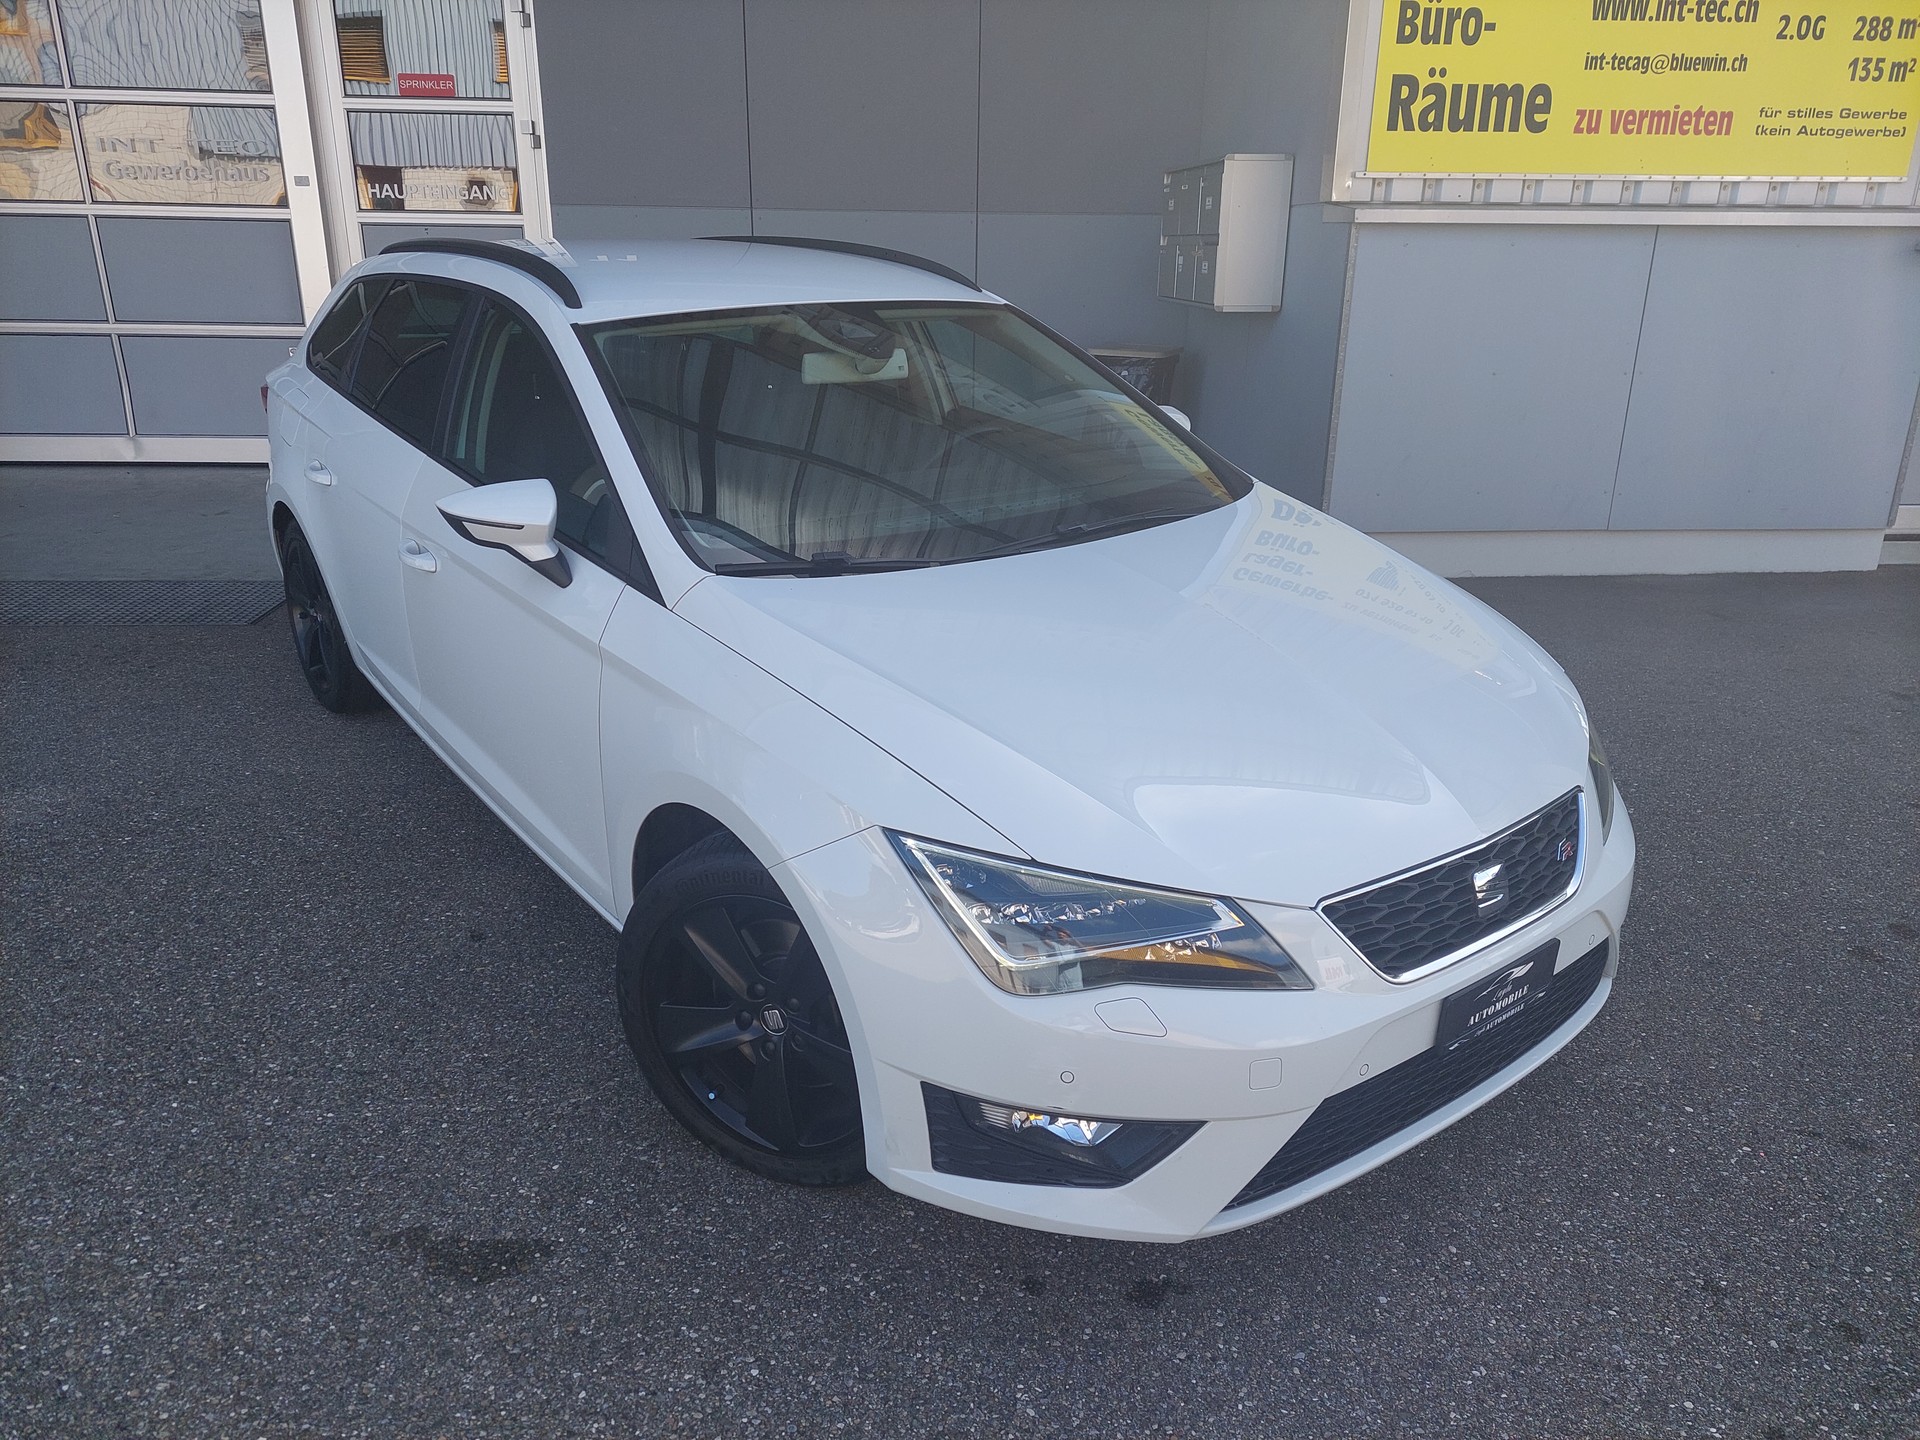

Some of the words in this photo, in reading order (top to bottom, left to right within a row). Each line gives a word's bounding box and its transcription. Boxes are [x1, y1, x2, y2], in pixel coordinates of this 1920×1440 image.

[1395, 0, 1497, 46] Büro-
[1592, 0, 1760, 23] www.int-tec.ch
[1852, 15, 1894, 42] 288
[1584, 52, 1748, 75] int-tecag@bluewin.ch
[1848, 57, 1886, 82] 135
[400, 79, 454, 90] SPRINKLER
[1386, 66, 1553, 134] Räume
[1573, 108, 1603, 135] zu
[1610, 104, 1734, 136] vermieten
[1759, 107, 1782, 119] für
[1787, 107, 1833, 119] stilles
[1839, 108, 1908, 120] Gewerbe
[1755, 125, 1791, 137] (kein
[1797, 125, 1907, 139] Autogewerbe)
[96, 136, 164, 154] INT
[103, 157, 271, 183] Gewerbehaus
[367, 182, 511, 201] HAUPTEINGANG
[1467, 984, 1530, 1028] AUTOMOBILE
